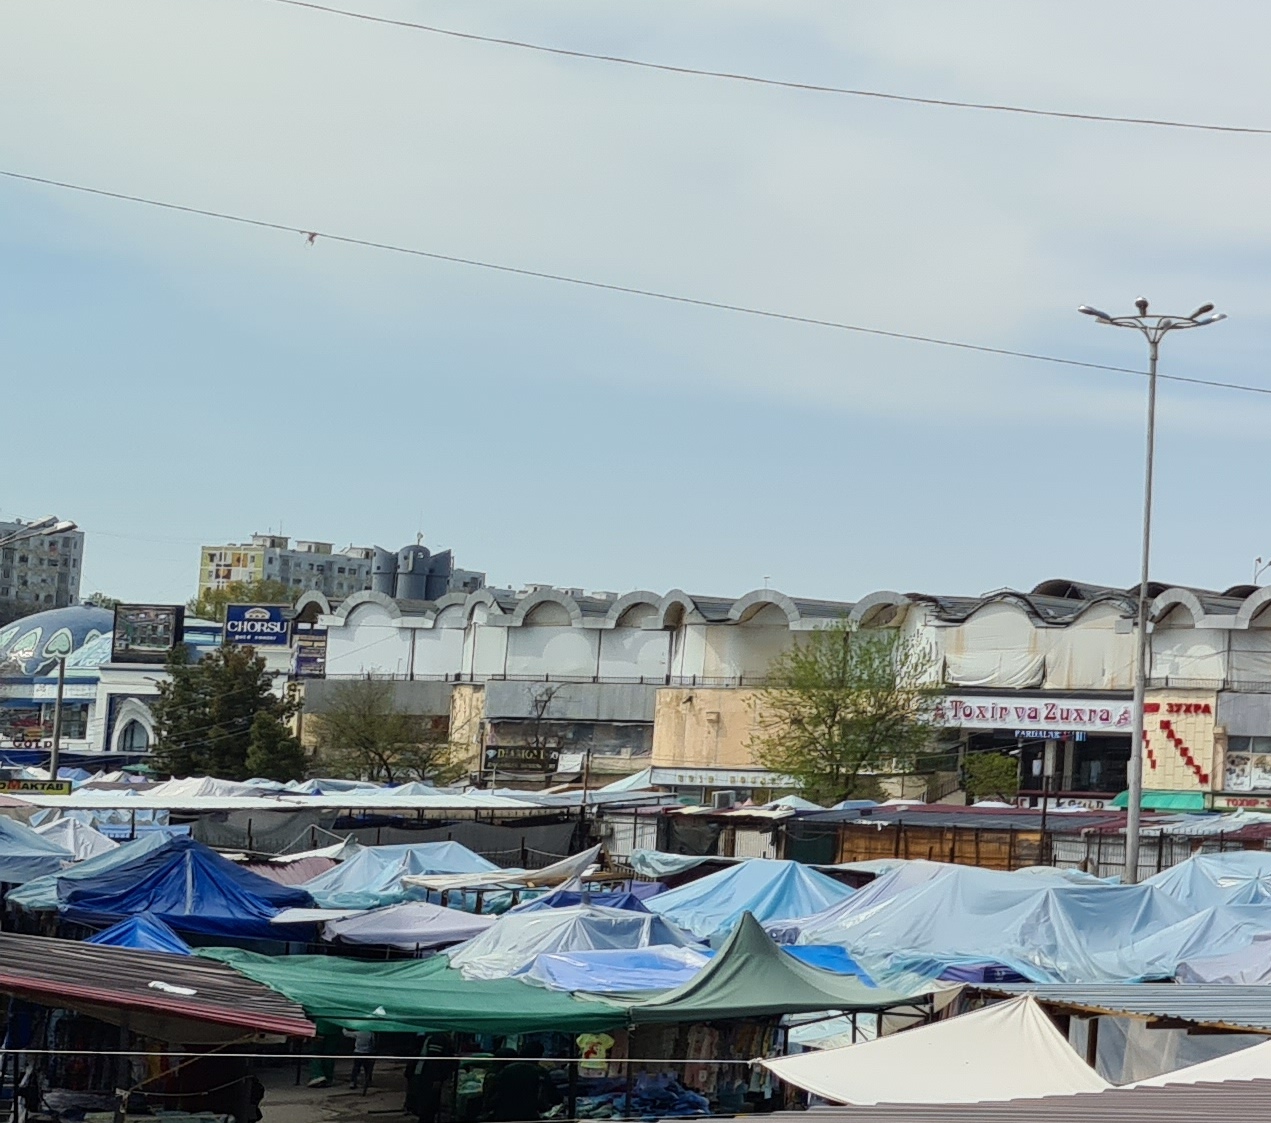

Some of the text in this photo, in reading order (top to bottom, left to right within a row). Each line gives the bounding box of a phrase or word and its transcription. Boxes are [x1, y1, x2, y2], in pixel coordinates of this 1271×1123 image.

[227, 620, 287, 633] CHORSU
[951, 700, 1111, 722] Toxir va Zuxra
[1166, 703, 1212, 714] ЗУХРА
